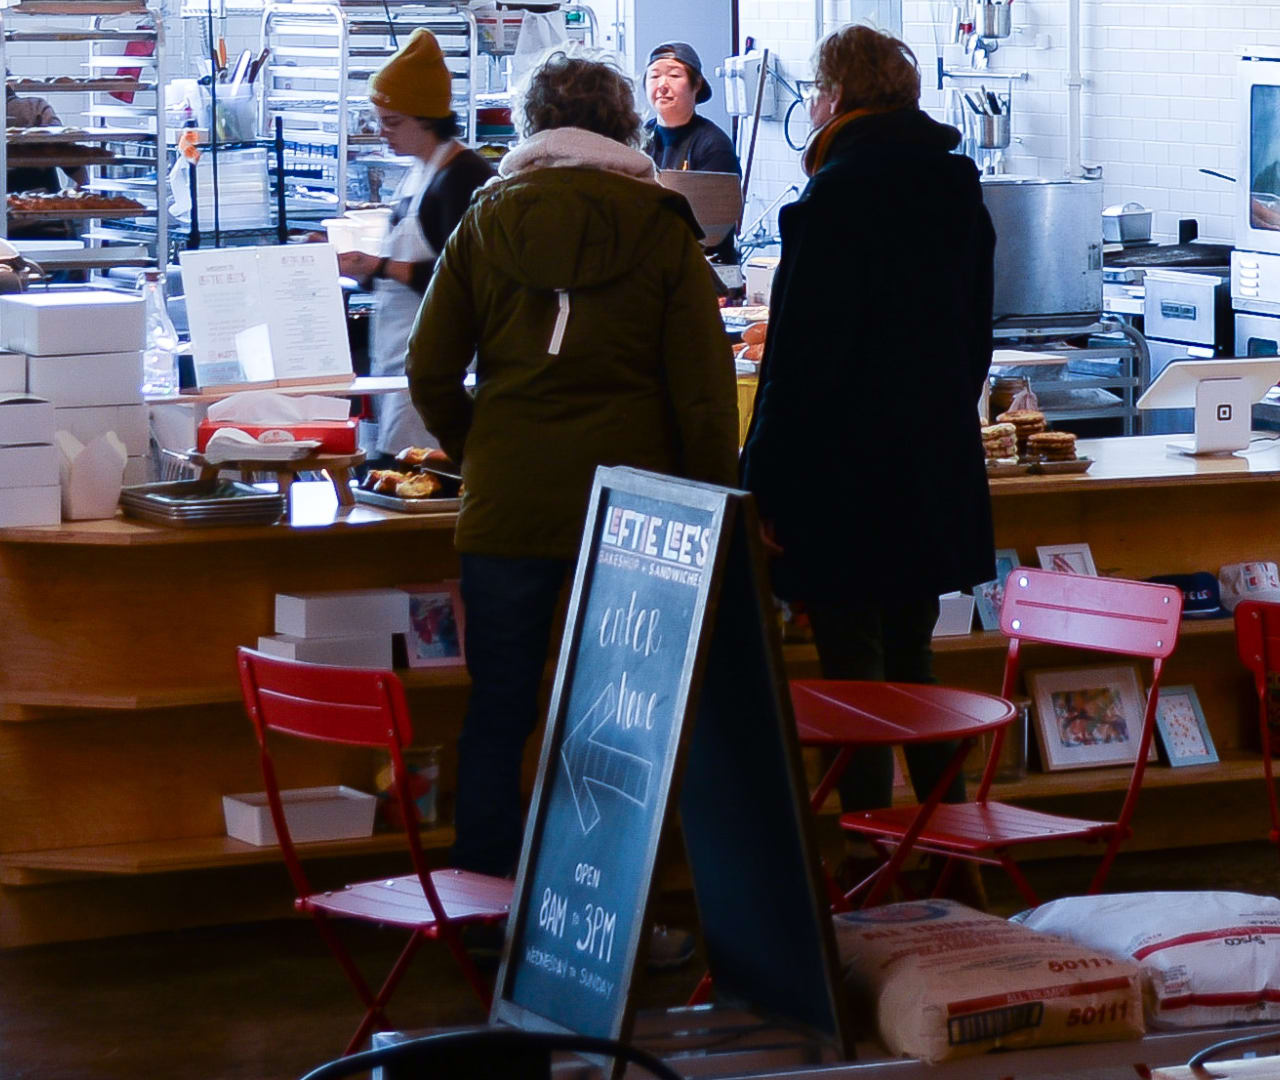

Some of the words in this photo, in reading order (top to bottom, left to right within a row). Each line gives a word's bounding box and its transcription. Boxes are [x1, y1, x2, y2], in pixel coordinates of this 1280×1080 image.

[602, 506, 663, 556] LEFTIE
[662, 520, 712, 567] LEE'S
[575, 862, 601, 888] OPEN
[540, 887, 569, 938] 8AM
[576, 903, 617, 964] 3PM
[1223, 934, 1266, 946] Sysco
[579, 967, 614, 1000] SUNDAY
[1065, 1000, 1129, 1028] 50111
